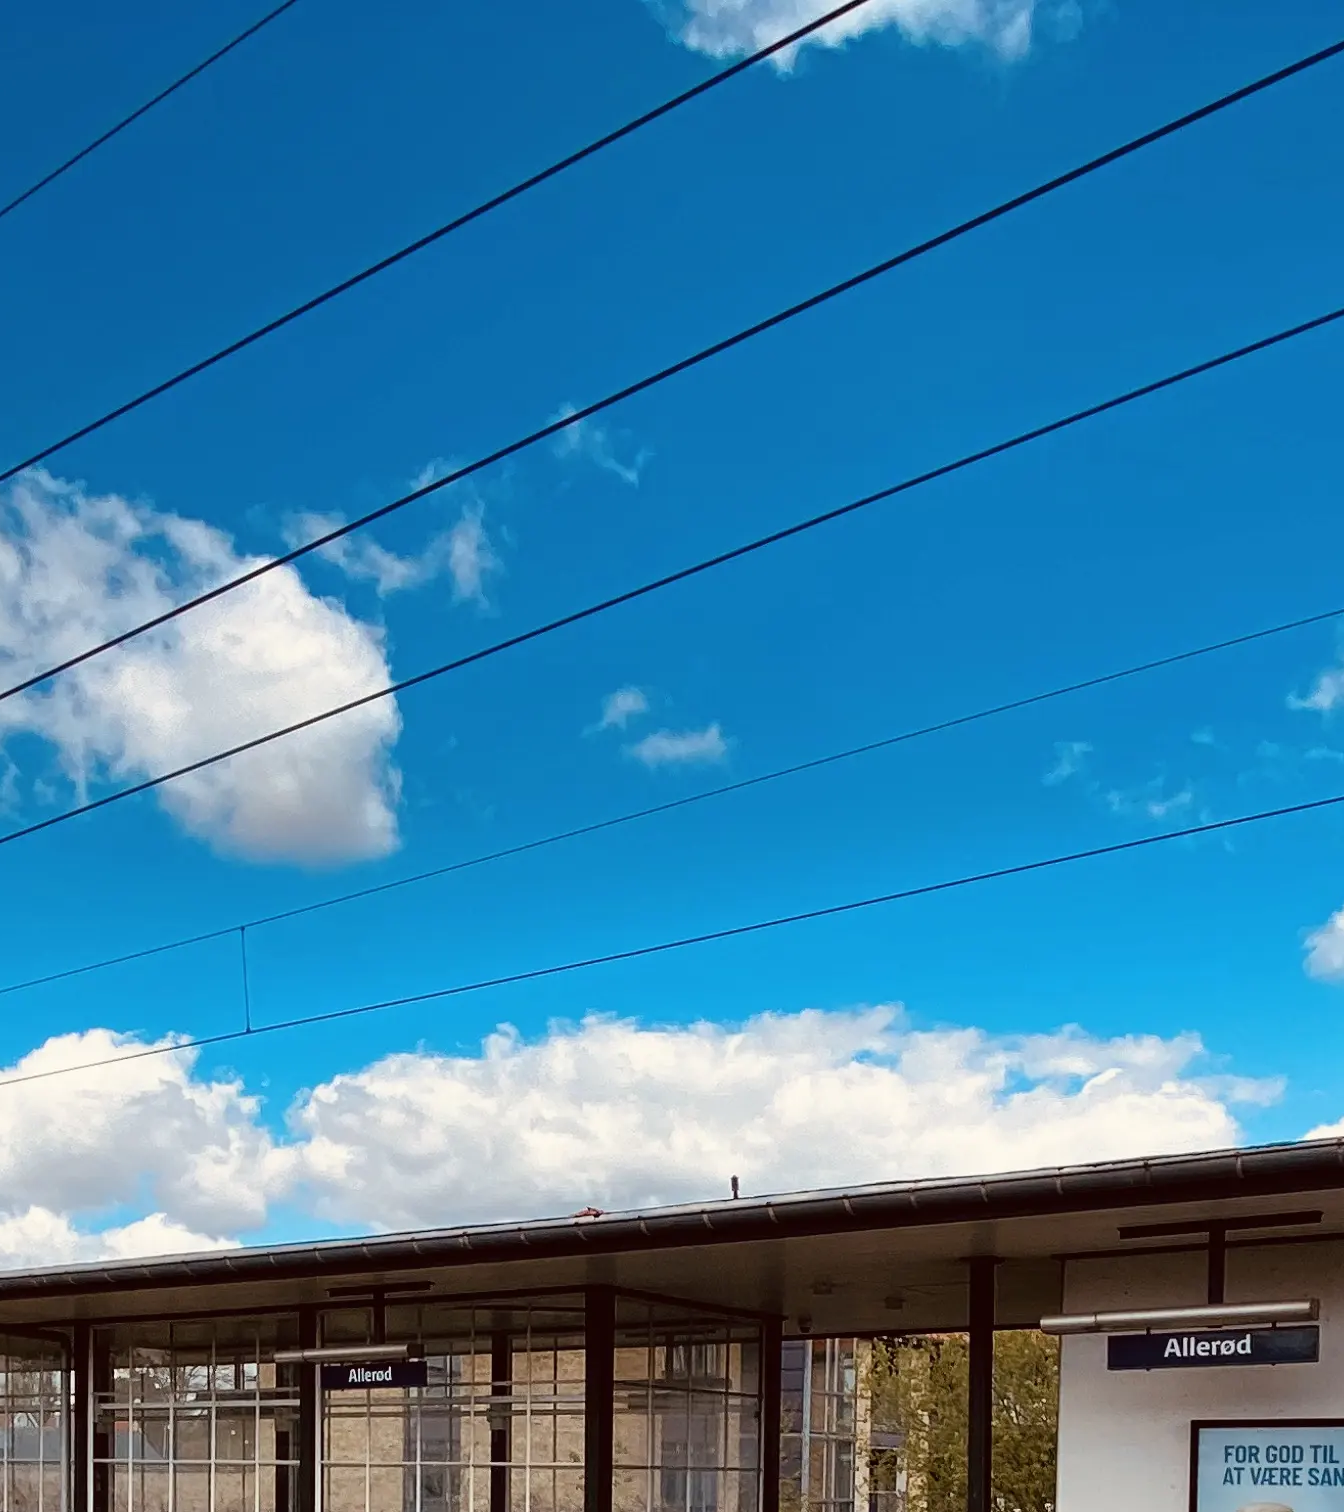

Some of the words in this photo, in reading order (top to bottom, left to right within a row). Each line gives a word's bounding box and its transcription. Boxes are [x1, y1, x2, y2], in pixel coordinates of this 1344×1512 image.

[1163, 1333, 1253, 1358] Allerød
[348, 1365, 393, 1383] Allerød
[1223, 1445, 1261, 1464] FOR
[1265, 1445, 1305, 1464] GOD
[1309, 1445, 1340, 1464] TIL
[1222, 1467, 1245, 1485] AT
[1250, 1467, 1304, 1486] VÆRE
